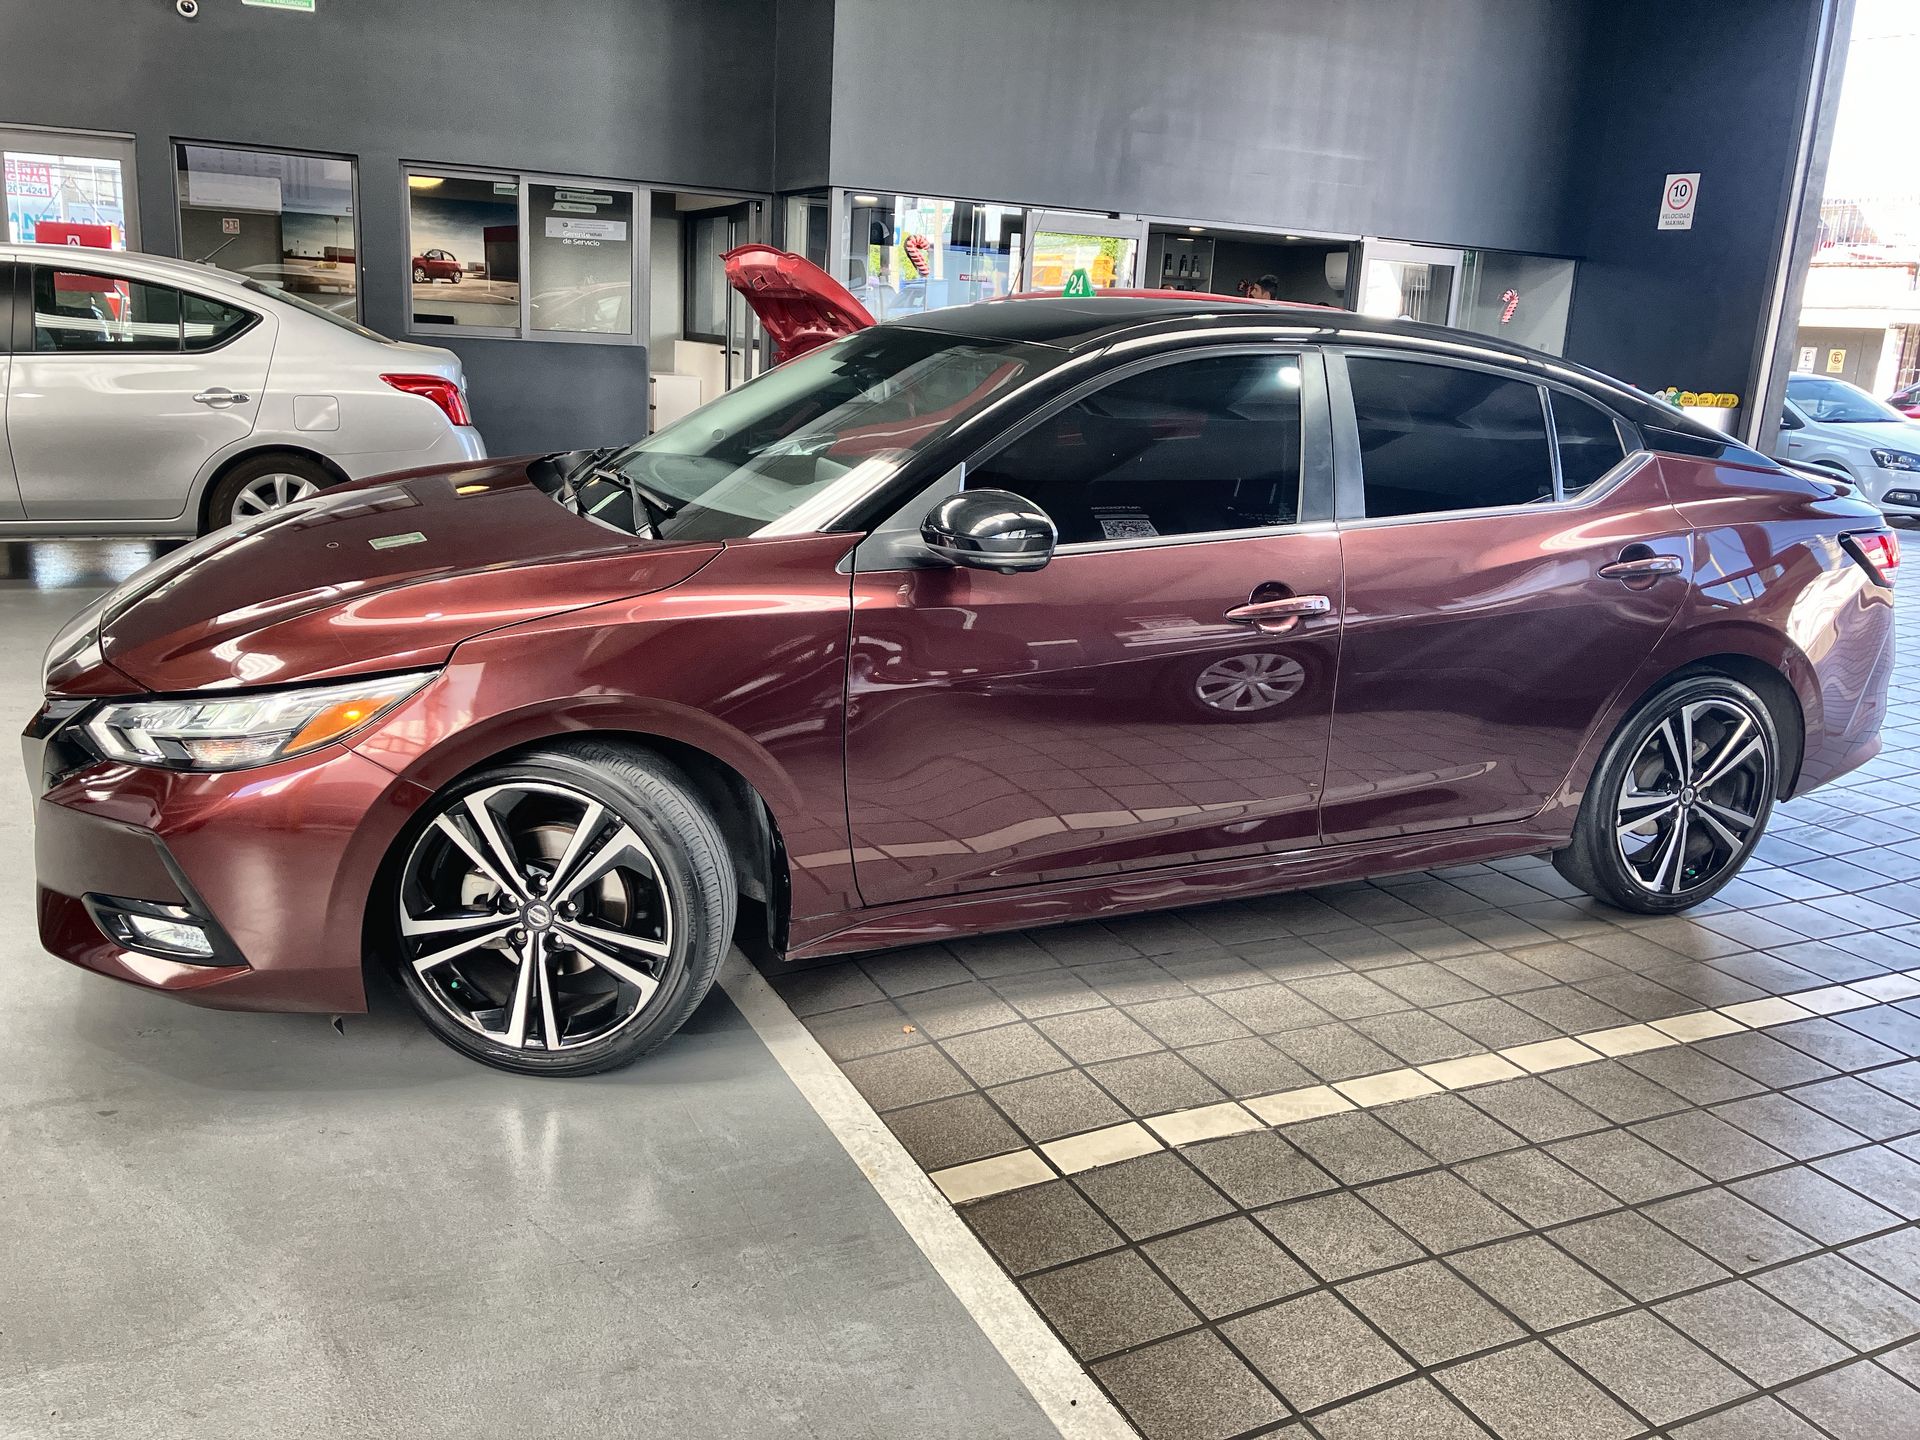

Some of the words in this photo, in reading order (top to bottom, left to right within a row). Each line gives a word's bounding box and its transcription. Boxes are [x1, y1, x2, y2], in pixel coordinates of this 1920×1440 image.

[1674, 184, 1687, 197] 10
[562, 230, 591, 238] Gerente
[573, 239, 600, 247] Servicio
[1069, 275, 1083, 294] 24
